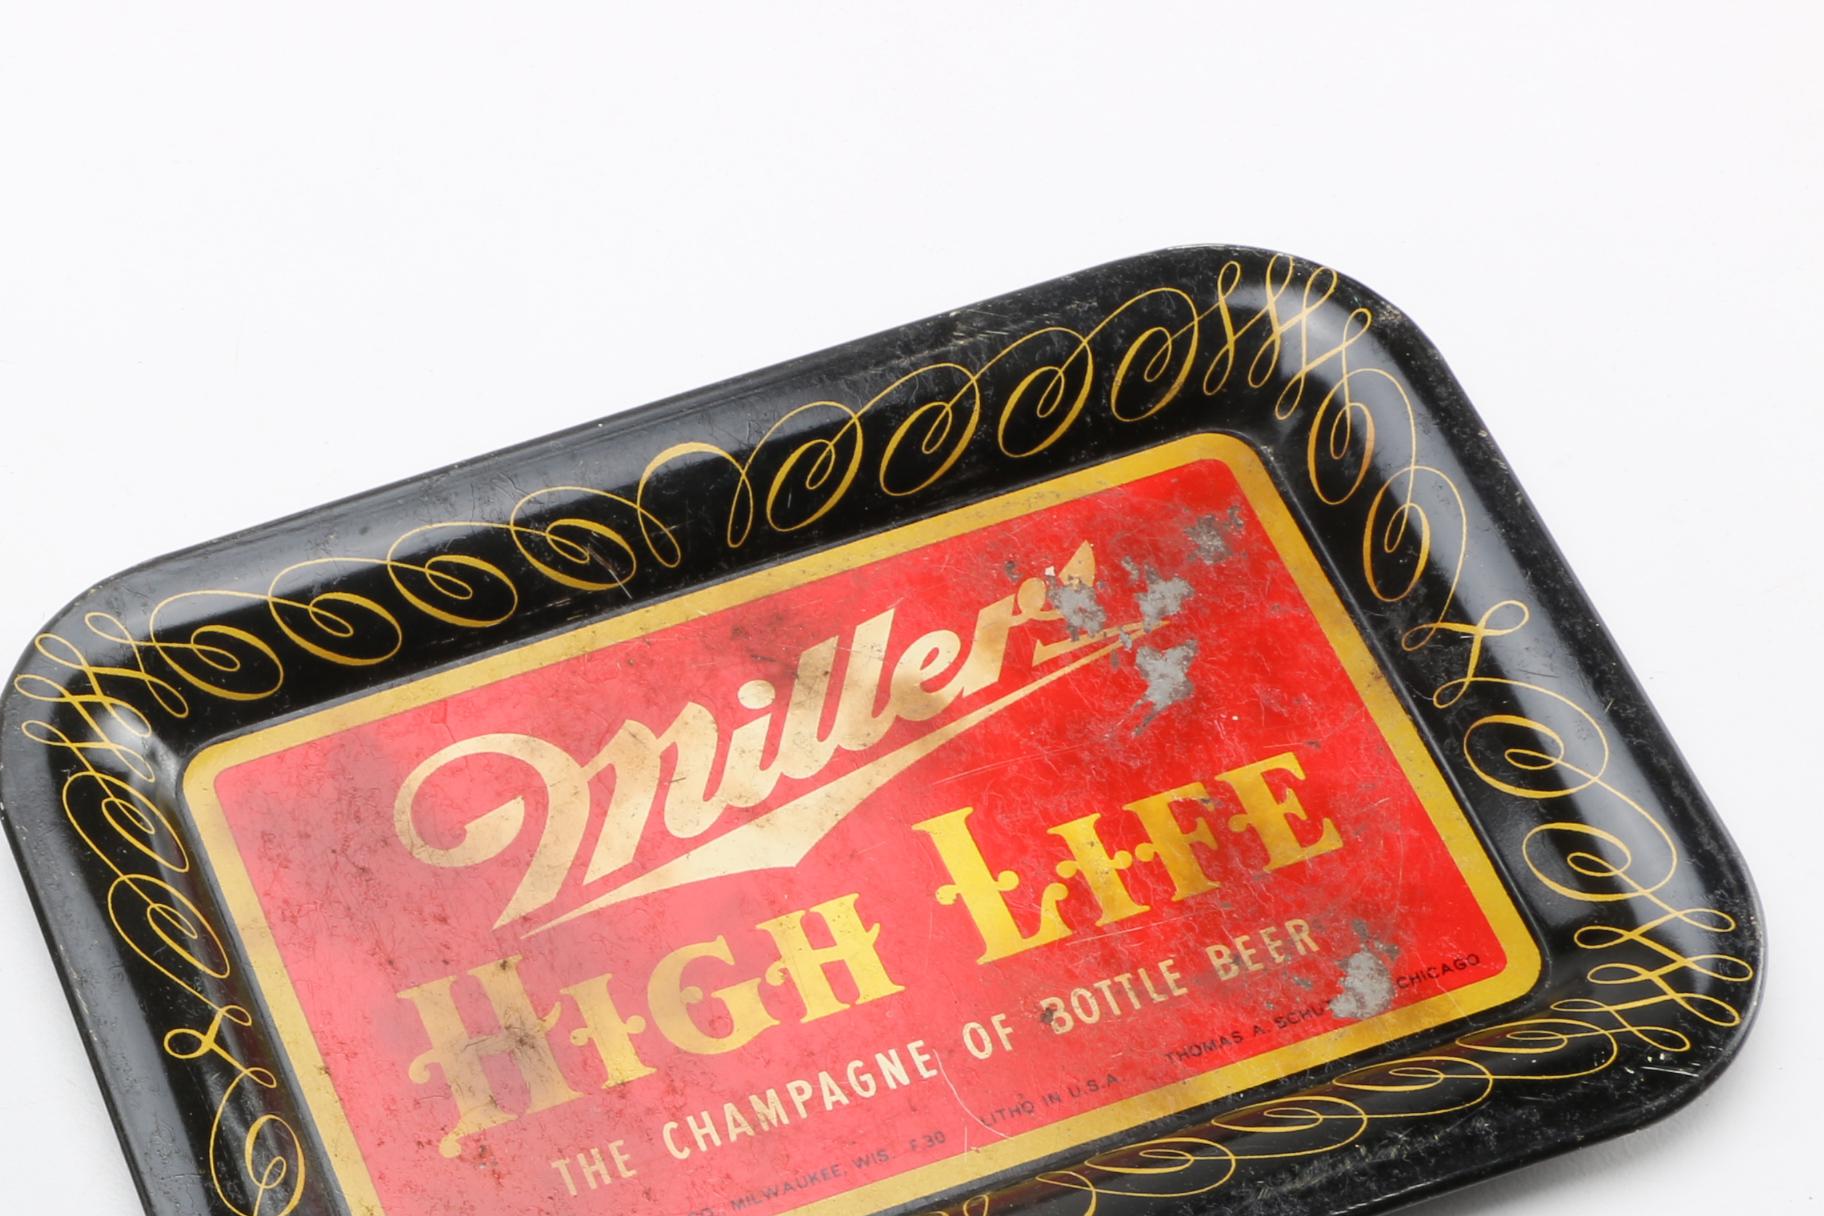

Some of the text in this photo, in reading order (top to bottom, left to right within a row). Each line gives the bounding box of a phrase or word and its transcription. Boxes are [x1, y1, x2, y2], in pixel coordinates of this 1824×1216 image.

[394, 540, 1097, 933] Miller
[398, 751, 1343, 1160] HIGH LIFE
[552, 918, 1321, 1198] THE CHAMPAGNE OF BOTTLE BEER
[1041, 1090, 1062, 1108] IN
[1164, 1028, 1244, 1067] THOMAS
[1275, 1000, 1330, 1030] SCHU
[1395, 951, 1481, 991] CHICAGO
